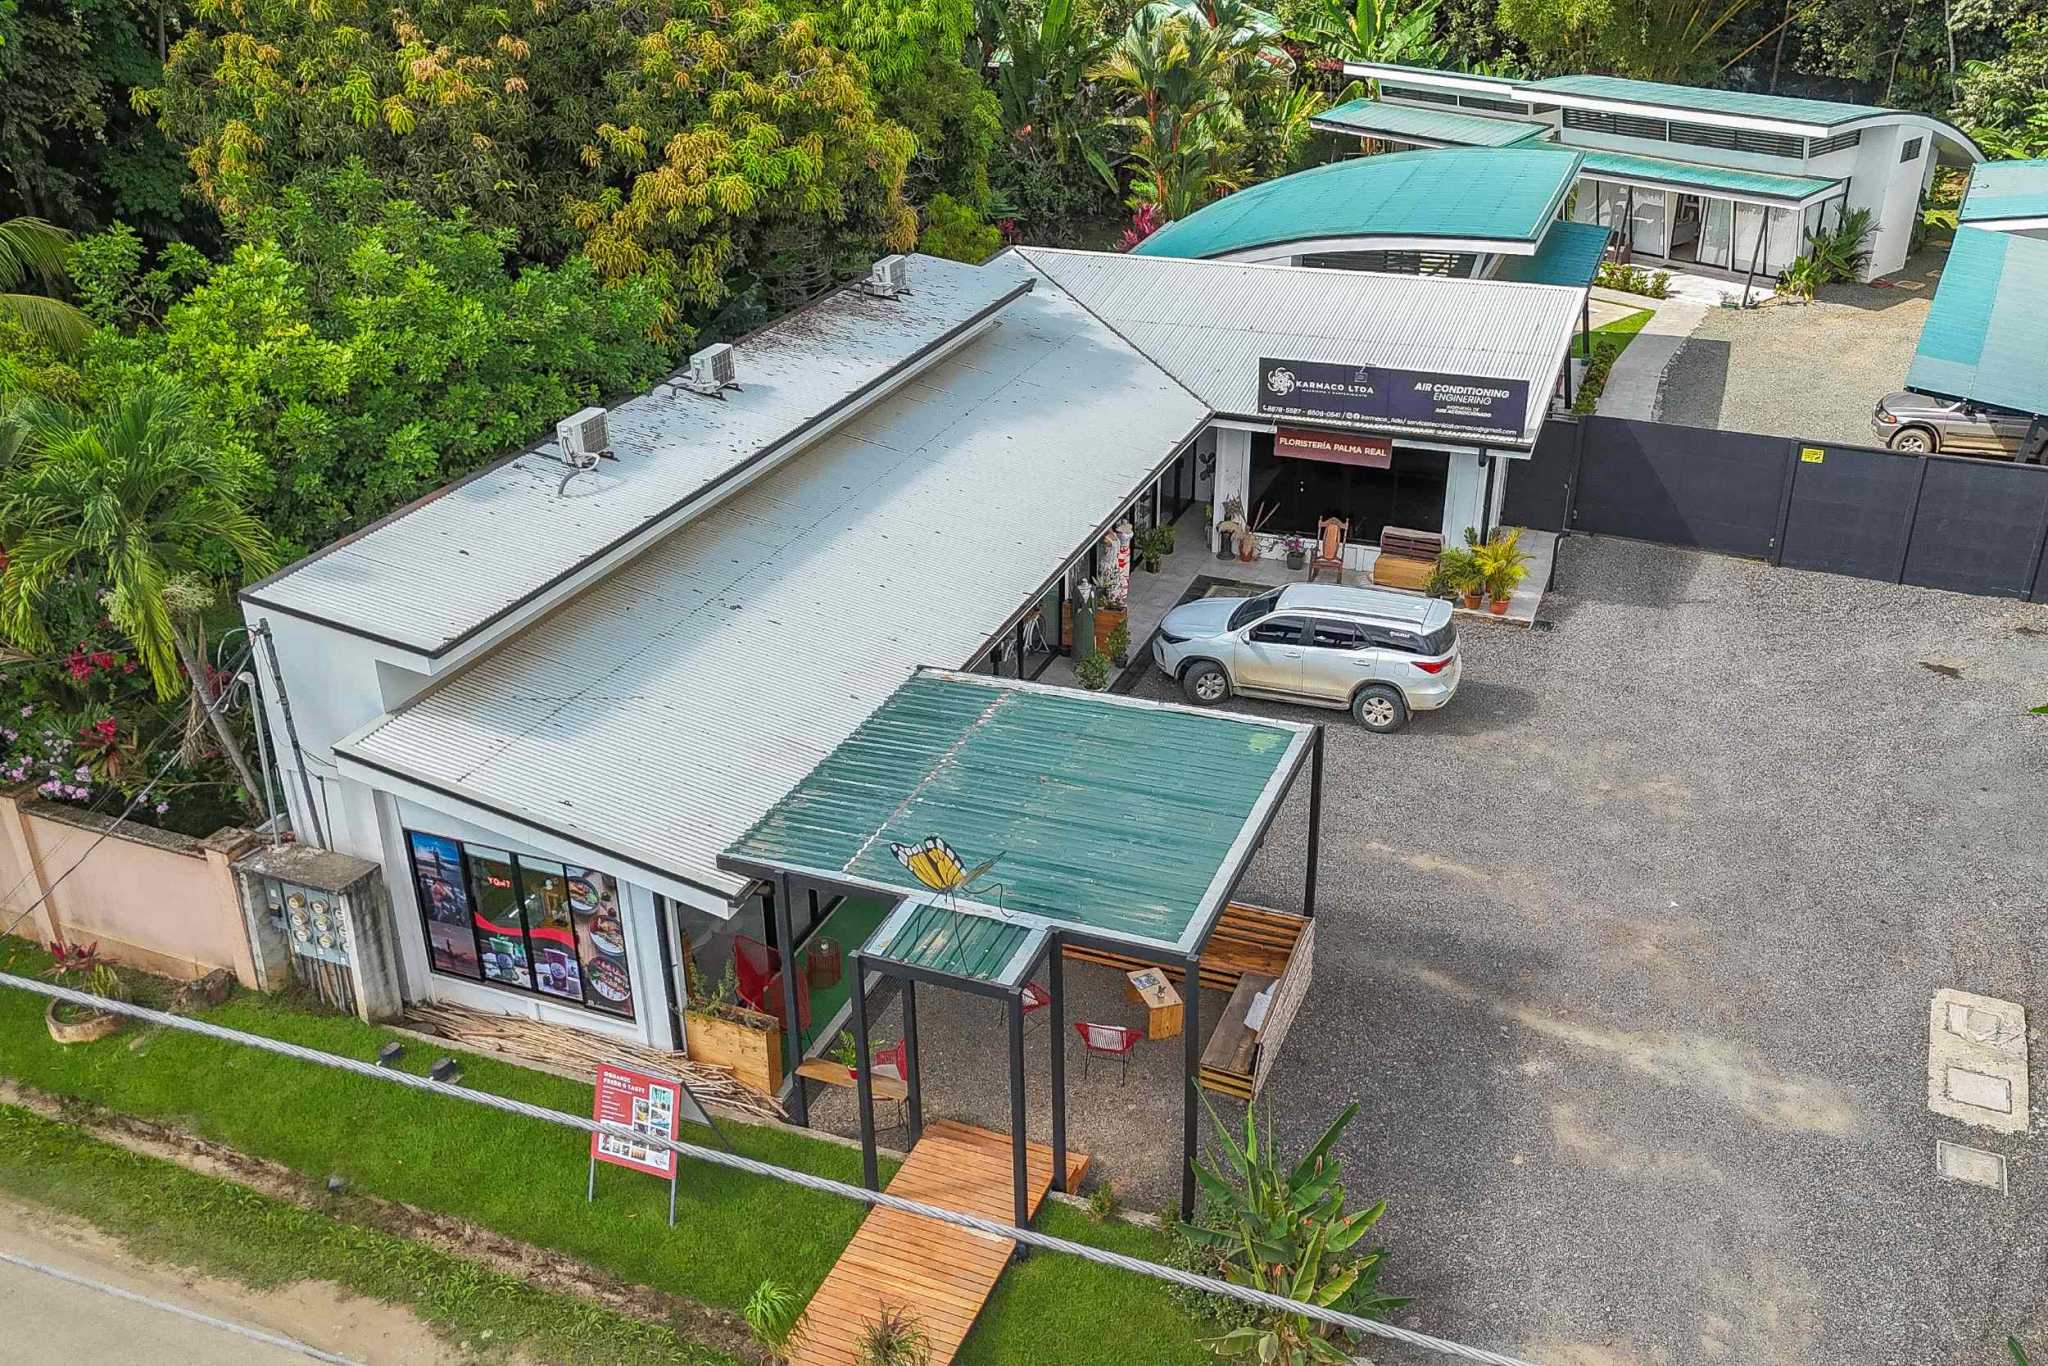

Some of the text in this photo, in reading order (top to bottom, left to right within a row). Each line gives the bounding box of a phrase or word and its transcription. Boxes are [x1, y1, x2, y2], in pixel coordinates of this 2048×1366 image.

[1296, 380, 1344, 391] KARMACO
[1348, 385, 1374, 394] LTDA
[1414, 382, 1510, 399] AIR CONDITIONING
[1433, 392, 1492, 406] ENGINERING
[1279, 437, 1387, 457] FLORISTERÍA PALMA REAL
